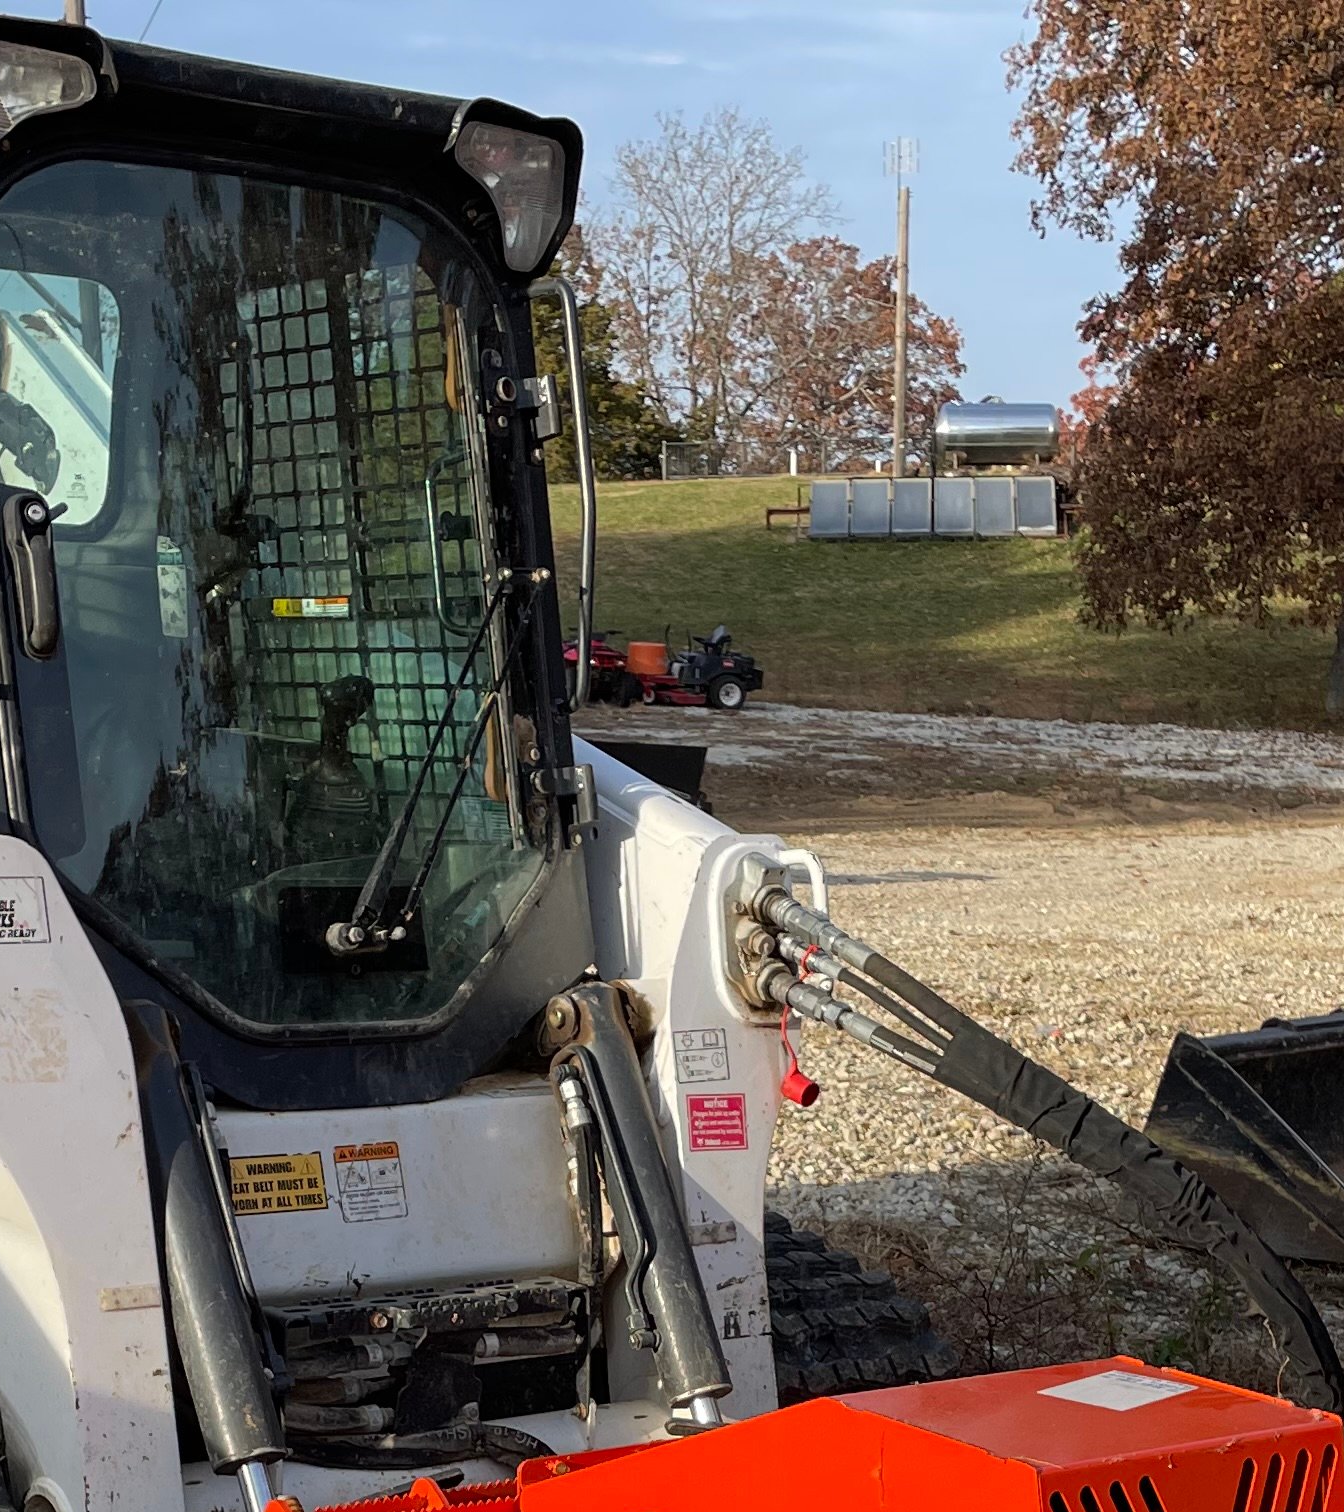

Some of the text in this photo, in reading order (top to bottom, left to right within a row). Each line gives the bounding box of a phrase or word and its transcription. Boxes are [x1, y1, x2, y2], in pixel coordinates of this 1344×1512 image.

[348, 1145, 394, 1157] WARNING
[231, 1177, 319, 1194] EAT BELT MUST BE
[262, 1197, 272, 1208] AT
[277, 1196, 292, 1207] ALL
[295, 1193, 323, 1206] TIMES
